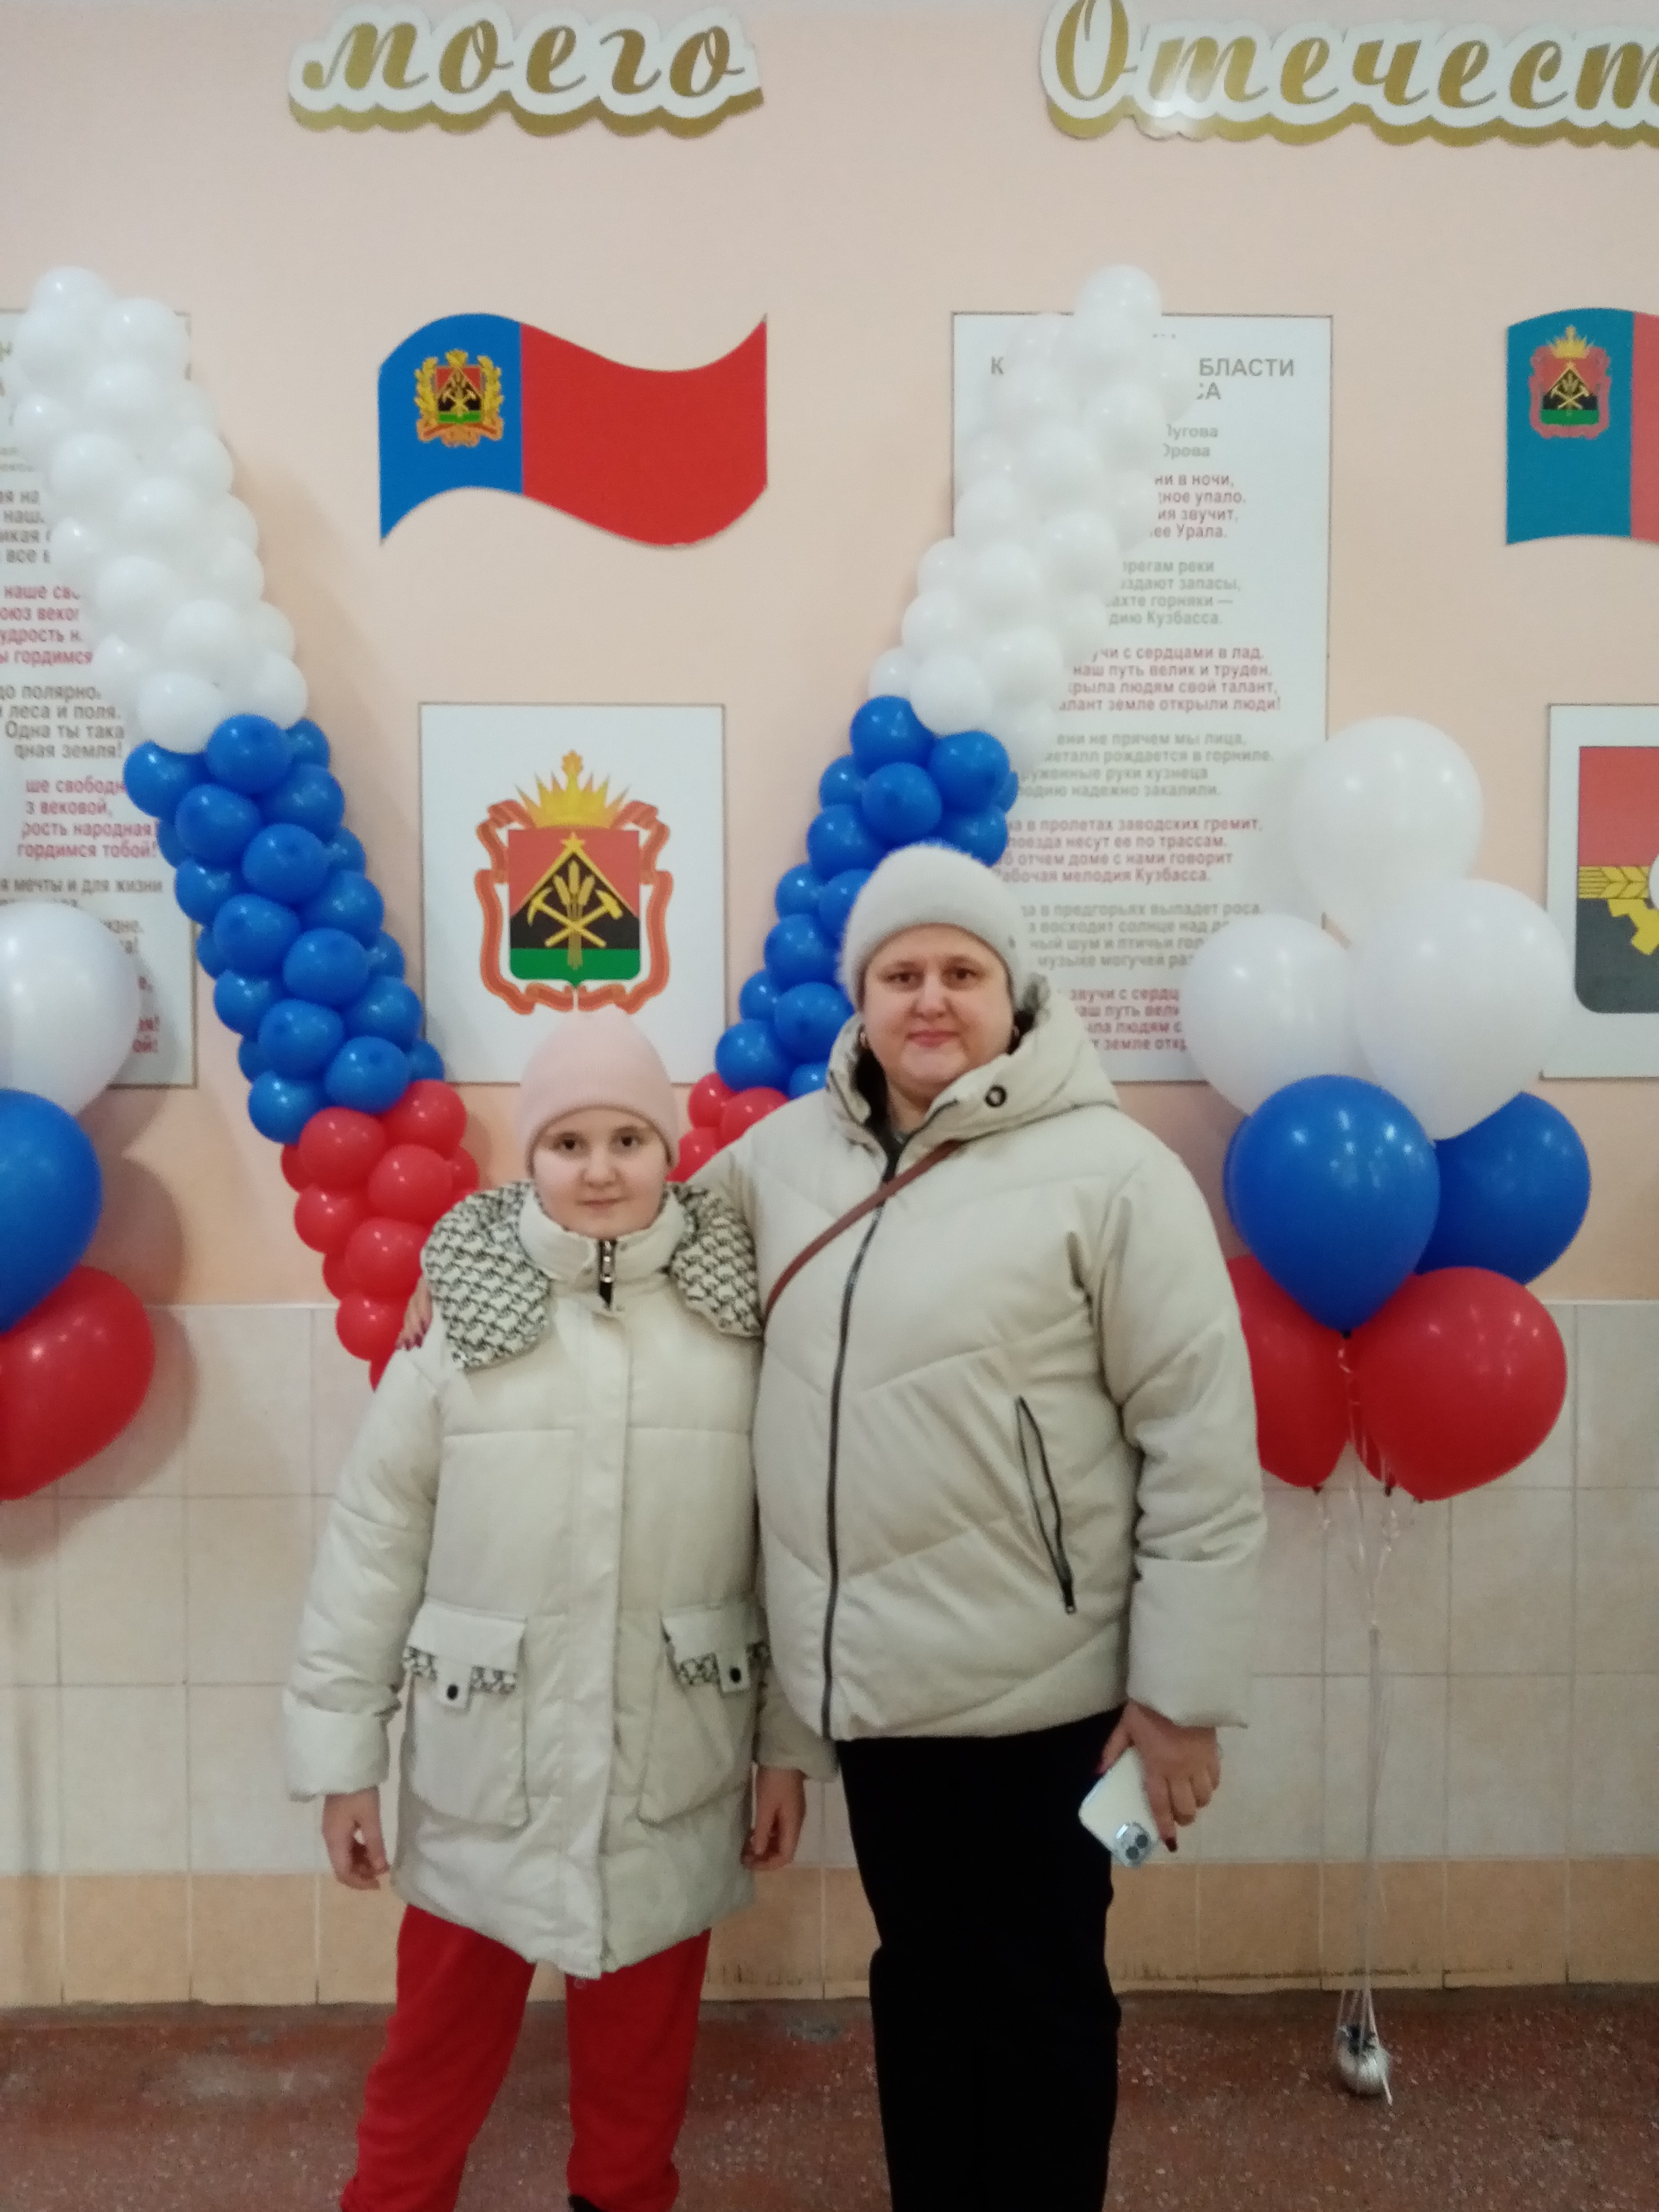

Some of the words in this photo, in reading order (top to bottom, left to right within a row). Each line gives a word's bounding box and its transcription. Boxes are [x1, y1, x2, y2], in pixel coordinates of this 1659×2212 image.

[299, 18, 747, 99] моего
[1178, 474, 1187, 485] в
[1191, 474, 1234, 488] ночи,
[1194, 491, 1247, 506] упало.
[3, 510, 45, 525] наш
[1180, 508, 1239, 524] звучит,
[1149, 526, 1171, 538] ее
[1175, 523, 1228, 541] Урала.
[1135, 647, 1214, 663] сердцами
[1218, 647, 1227, 659] в
[1109, 665, 1145, 680] путь
[1149, 665, 1195, 677] велик
[1200, 665, 1209, 676] и
[21, 684, 102, 704] полярно
[1120, 682, 1175, 696] людям
[1178, 678, 1217, 694] свой
[1108, 699, 1155, 711] земле
[1159, 699, 1229, 714] открыли
[1075, 1005, 1101, 1018] аш
